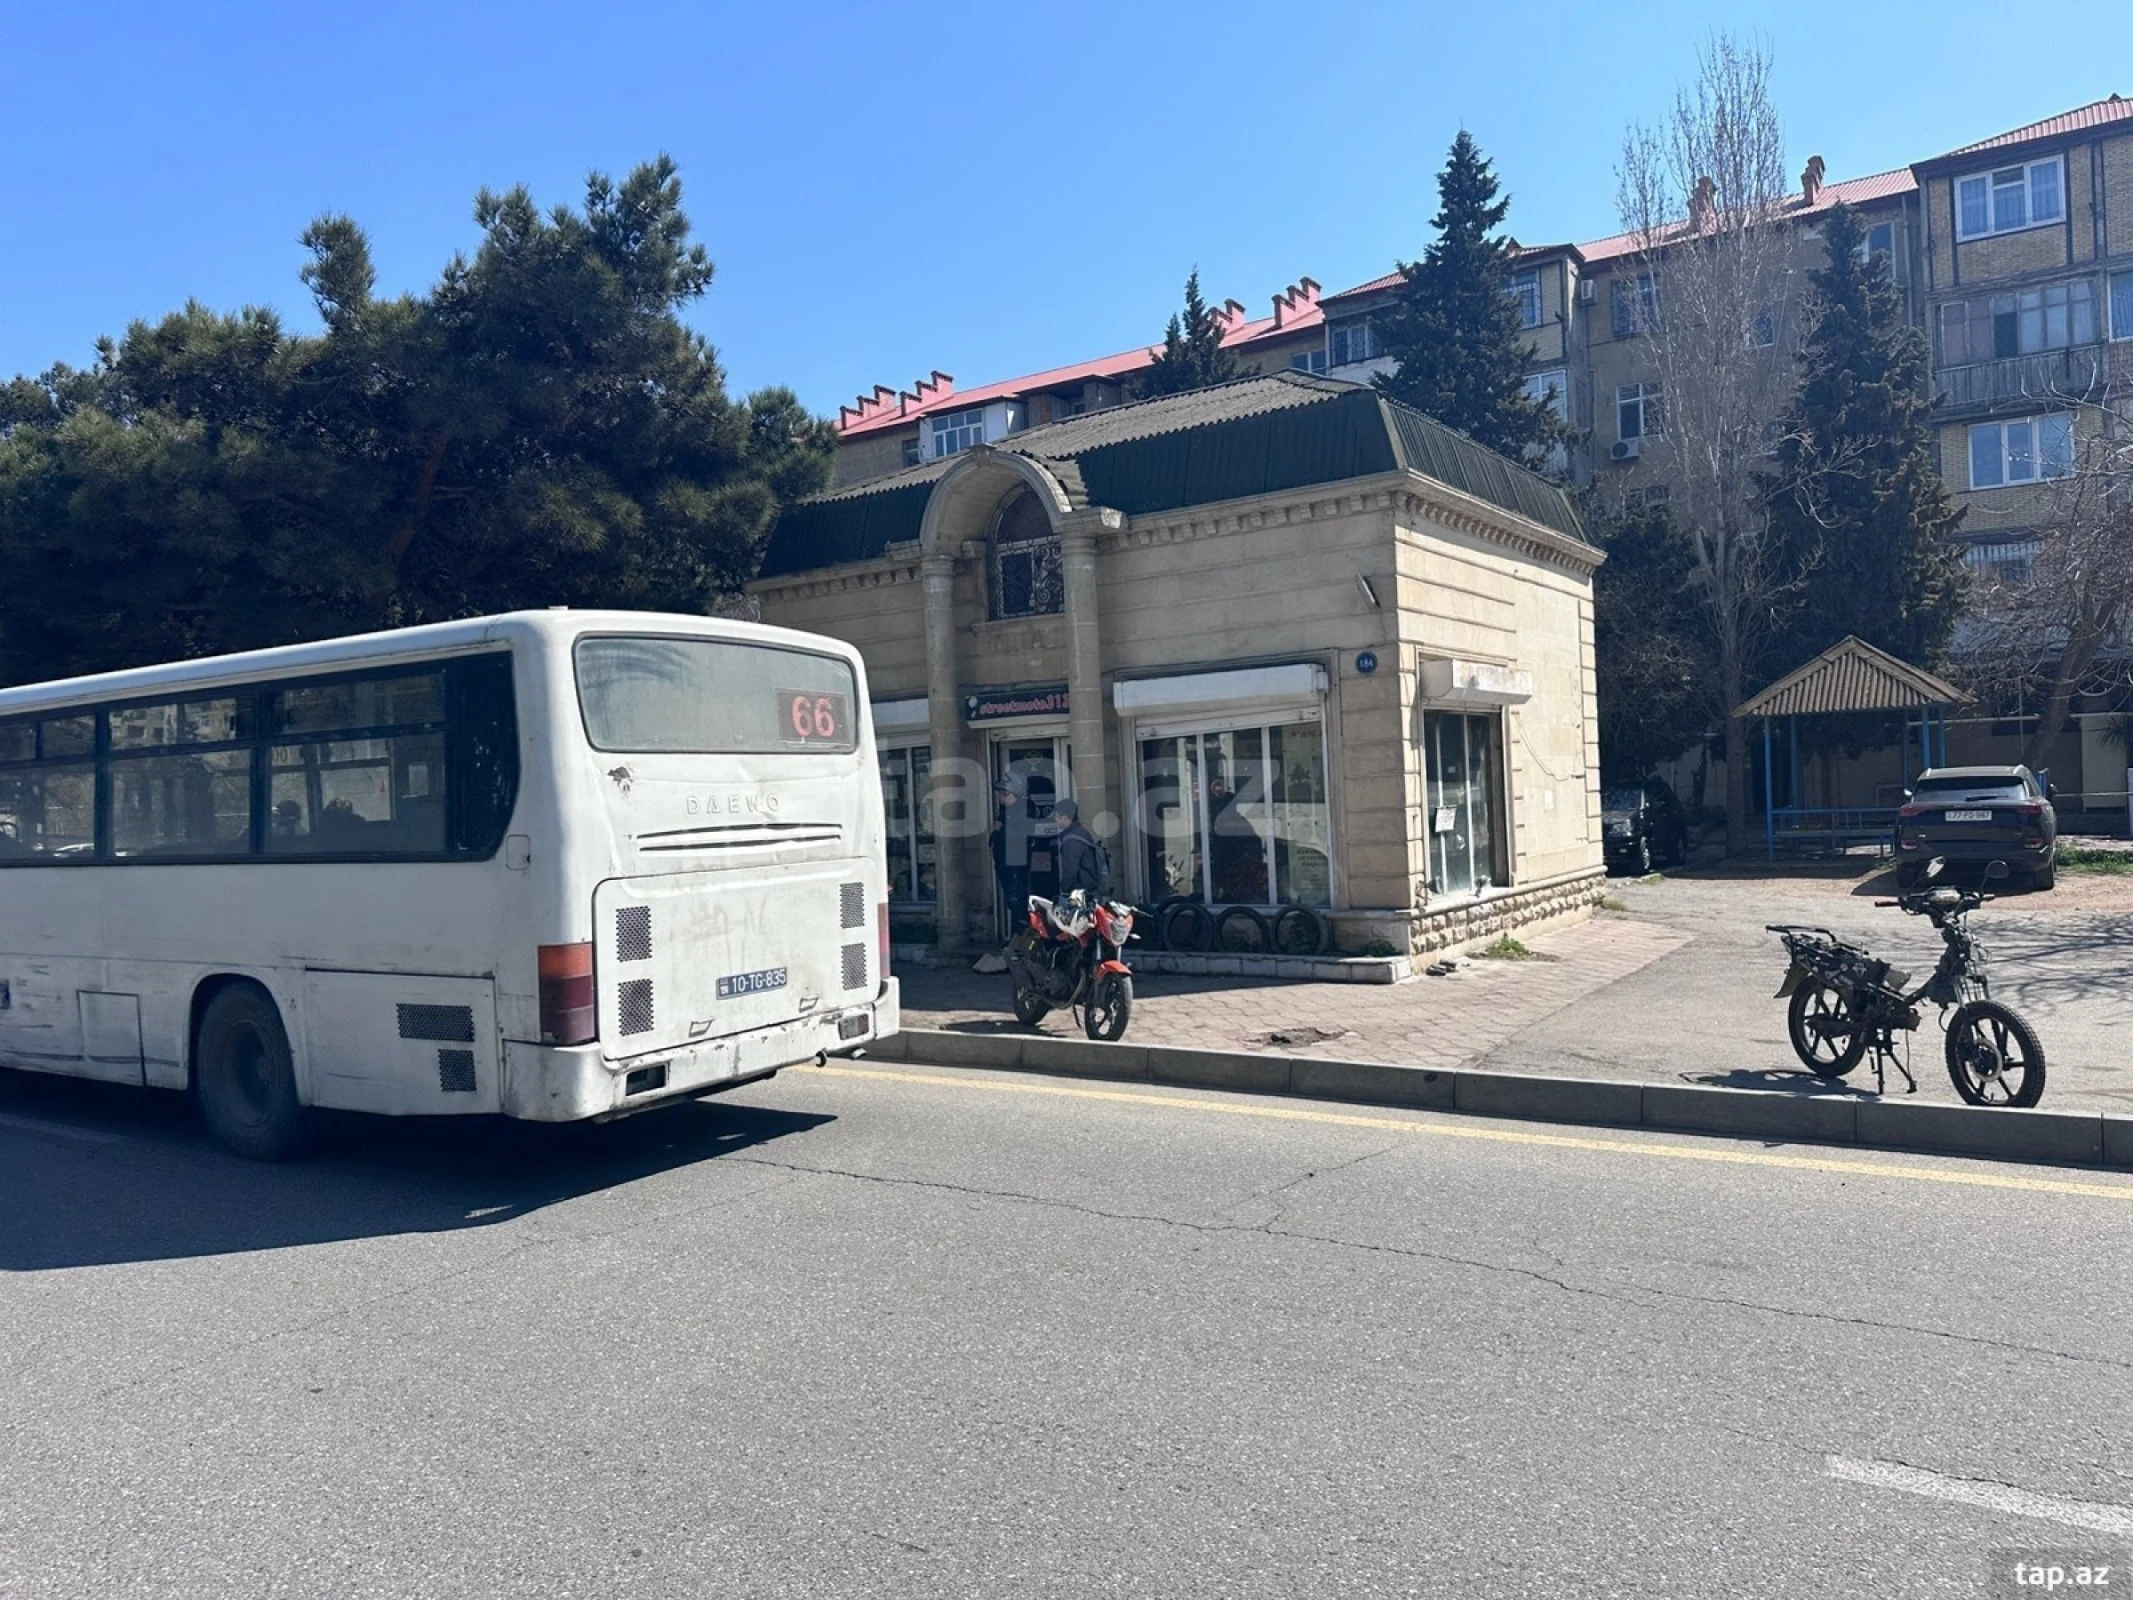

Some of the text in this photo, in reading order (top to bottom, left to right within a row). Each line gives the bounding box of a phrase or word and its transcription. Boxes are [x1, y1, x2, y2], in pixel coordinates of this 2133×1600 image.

[790, 696, 835, 738] 66
[686, 793, 781, 816] DAEWO
[731, 969, 787, 993] 10-TG-835
